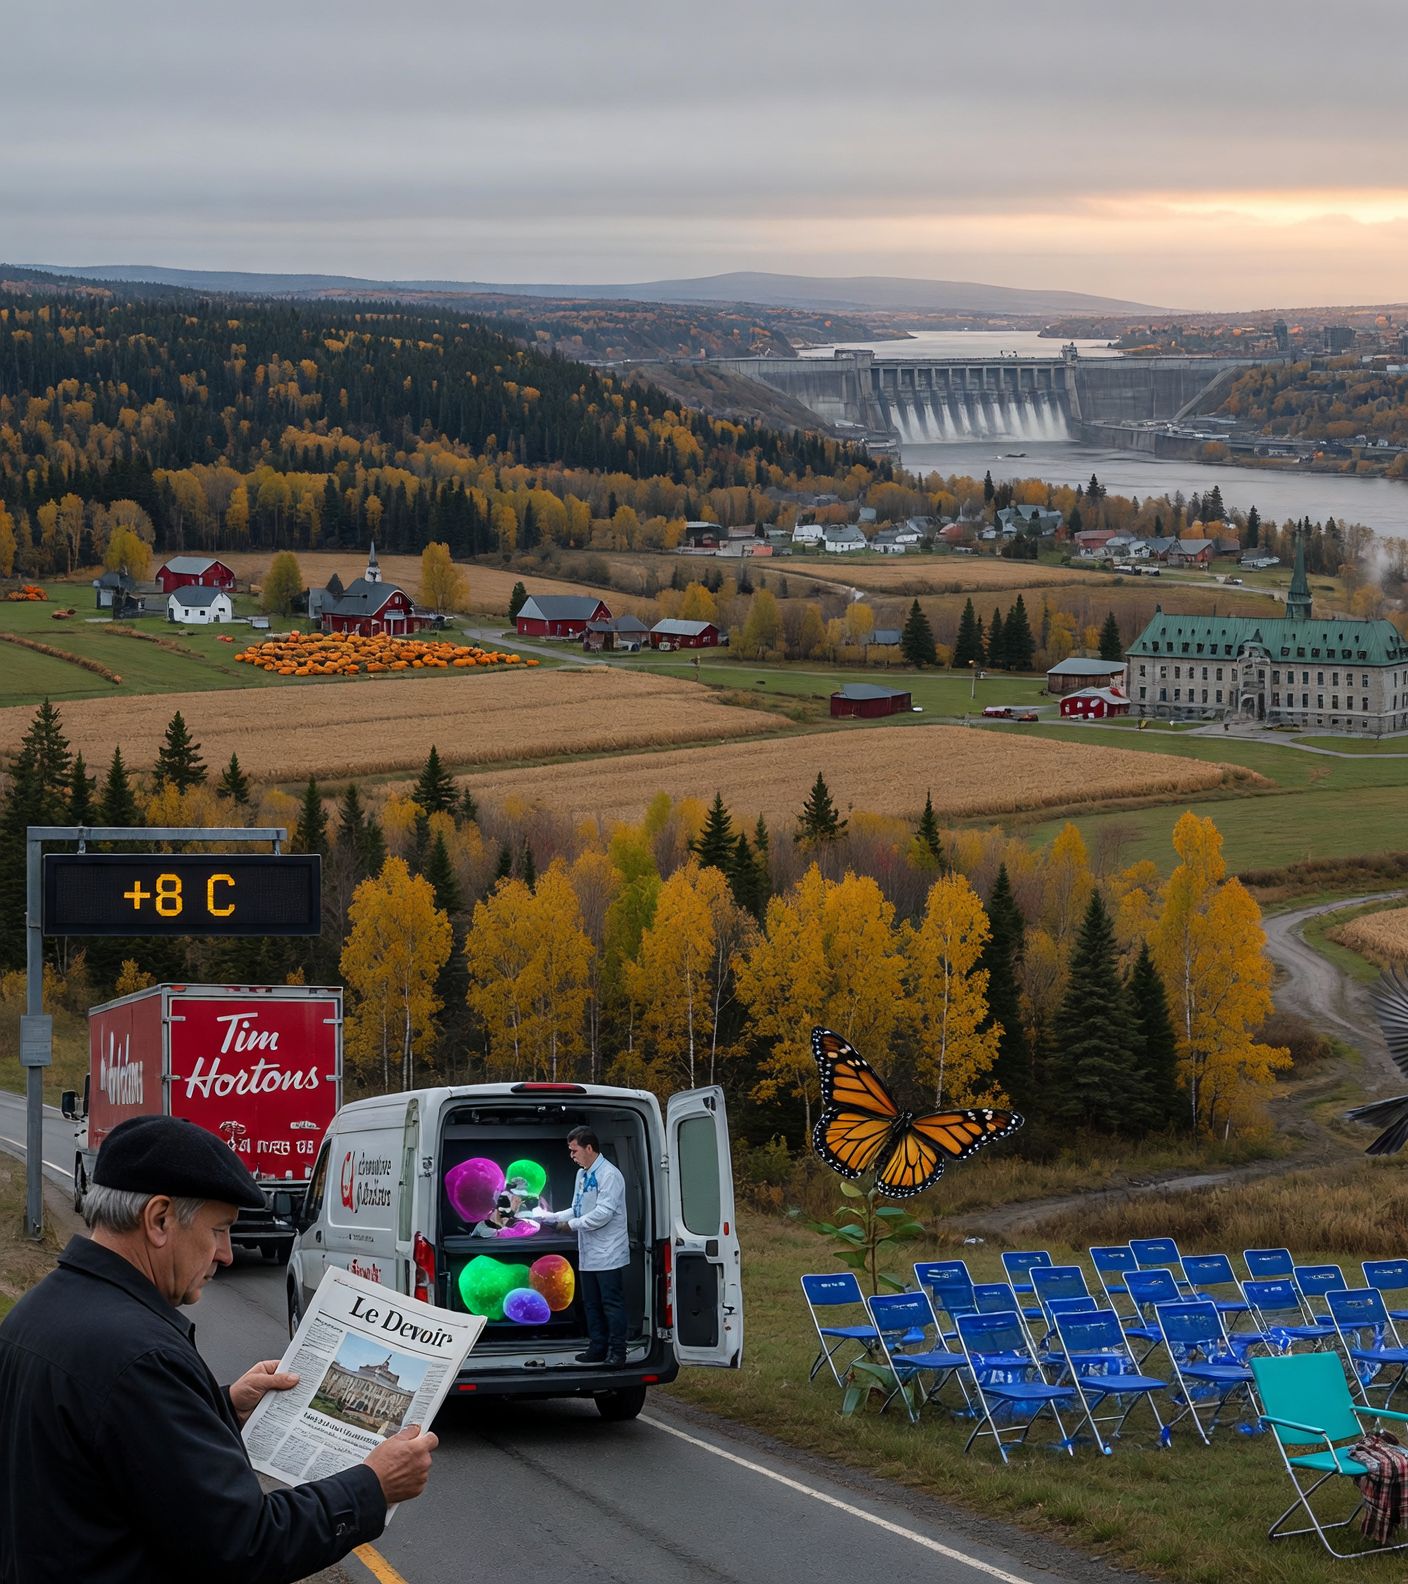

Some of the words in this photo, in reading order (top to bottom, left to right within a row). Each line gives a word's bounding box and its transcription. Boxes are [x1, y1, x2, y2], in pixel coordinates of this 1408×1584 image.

[123, 873, 183, 917] +8
[206, 873, 236, 917] C
[216, 1012, 280, 1054] Tim
[184, 1056, 319, 1099] Hortons
[348, 1295, 379, 1325] Le
[382, 1309, 452, 1348] Devoir
